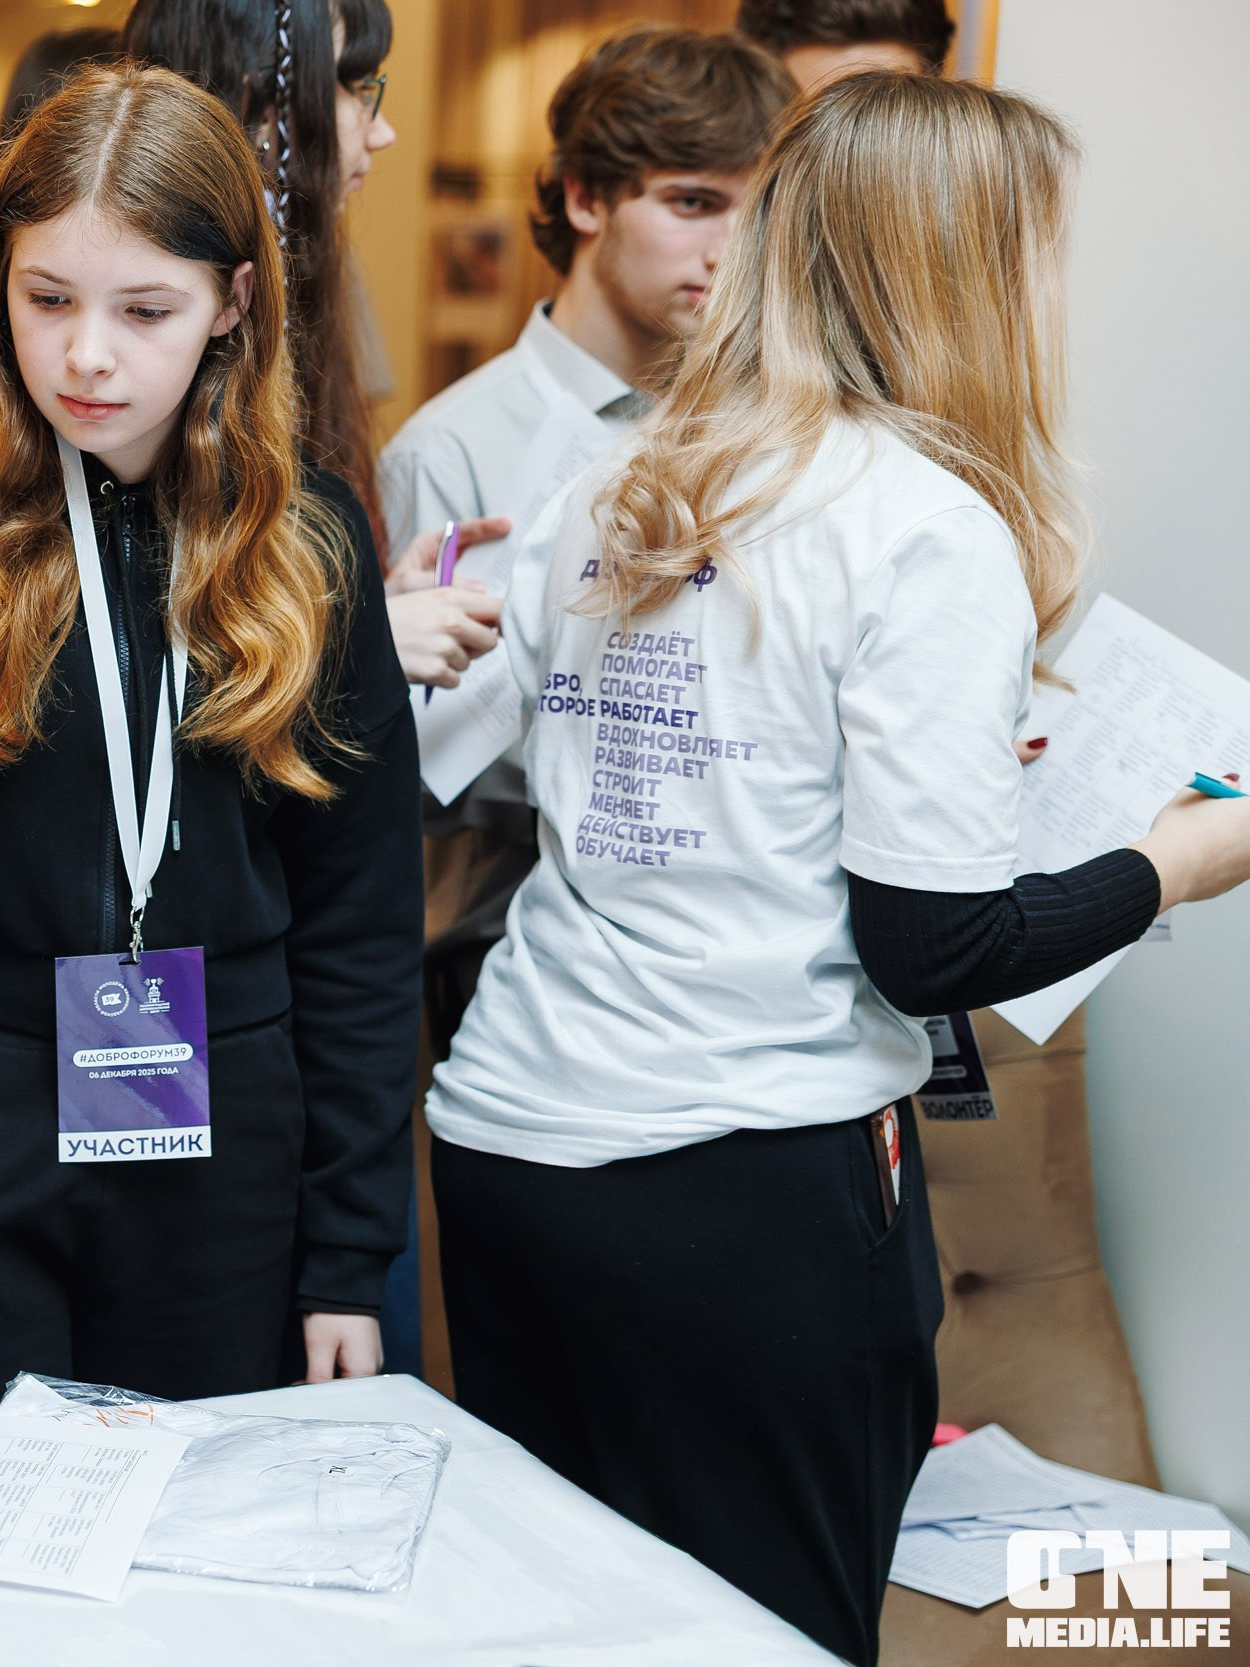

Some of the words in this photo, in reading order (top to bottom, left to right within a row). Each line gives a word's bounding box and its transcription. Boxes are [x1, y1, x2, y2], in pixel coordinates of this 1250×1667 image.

[607, 631, 695, 657] СОЗДАЁТ
[602, 653, 707, 683] ПОМОГАЕТ
[600, 677, 686, 704] СПАСАЕТ
[601, 700, 699, 729] РАБОТАЕТ
[598, 723, 758, 761] ВДОХНОВЛЯЕТ
[595, 746, 709, 779] РАЗВИВАЕТ
[593, 769, 662, 797] СТРОИТ
[589, 793, 661, 821] МЕНЯЕТ
[577, 813, 707, 849] ДЕЙСТВУЕТ
[575, 835, 671, 866] ОБУЧАЕТ
[80, 1047, 187, 1063] #ДОБРОФОРУМ39
[100, 1069, 137, 1079] ДЕКАБРЯ
[138, 1067, 157, 1077] 2025
[157, 1066, 179, 1076] ГОДА
[67, 1133, 203, 1158] УЧАСТНИК
